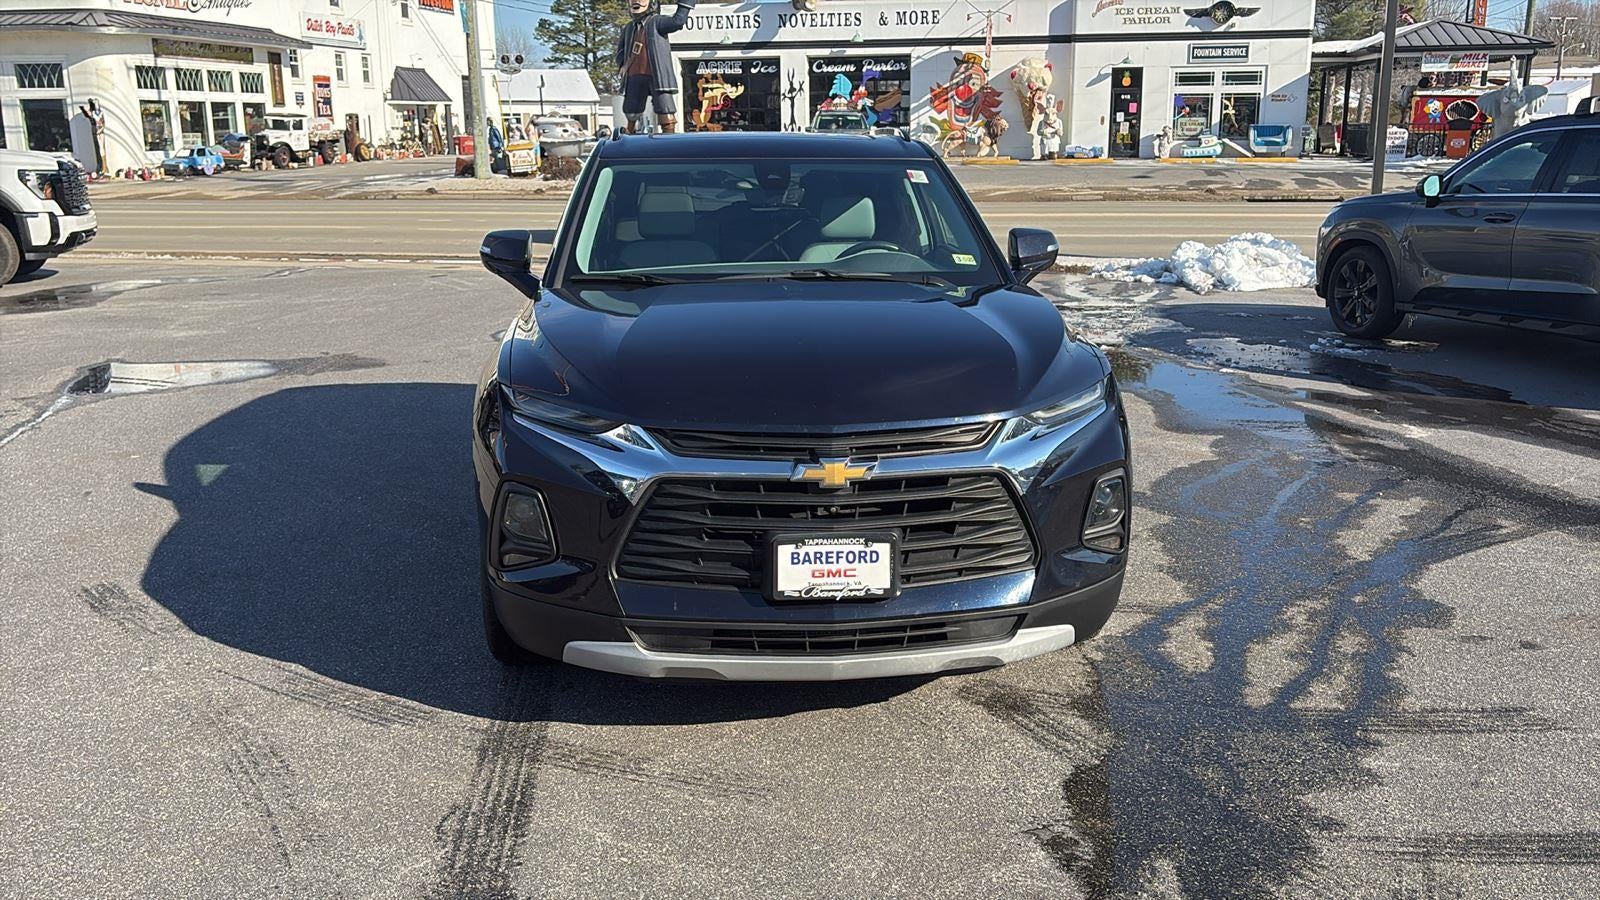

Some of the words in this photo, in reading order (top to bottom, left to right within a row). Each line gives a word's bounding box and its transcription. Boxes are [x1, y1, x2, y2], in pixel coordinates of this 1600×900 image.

[1115, 8, 1134, 16] ICE
[1137, 7, 1181, 15] CREAM
[685, 14, 761, 30] OUVENIRS
[778, 11, 862, 28] NOVELTIES
[878, 12, 889, 26] &
[895, 10, 941, 26] MORE
[1122, 16, 1171, 25] PARLOR
[306, 18, 323, 32] Dutch
[325, 21, 336, 37] Boy
[337, 21, 355, 37] Paints
[1193, 47, 1222, 57] FOUNTAIN
[1223, 47, 1247, 57] SERVICE
[696, 61, 742, 74] ACME
[750, 60, 778, 74] Ice
[812, 60, 856, 73] Cream
[862, 59, 908, 72] Parlor
[318, 102, 331, 116] TEA
[804, 538, 866, 546] TAPPAHANNOCK
[790, 550, 880, 565] BAREFORD
[811, 568, 857, 579] GMC
[801, 585, 868, 601] Bareford
